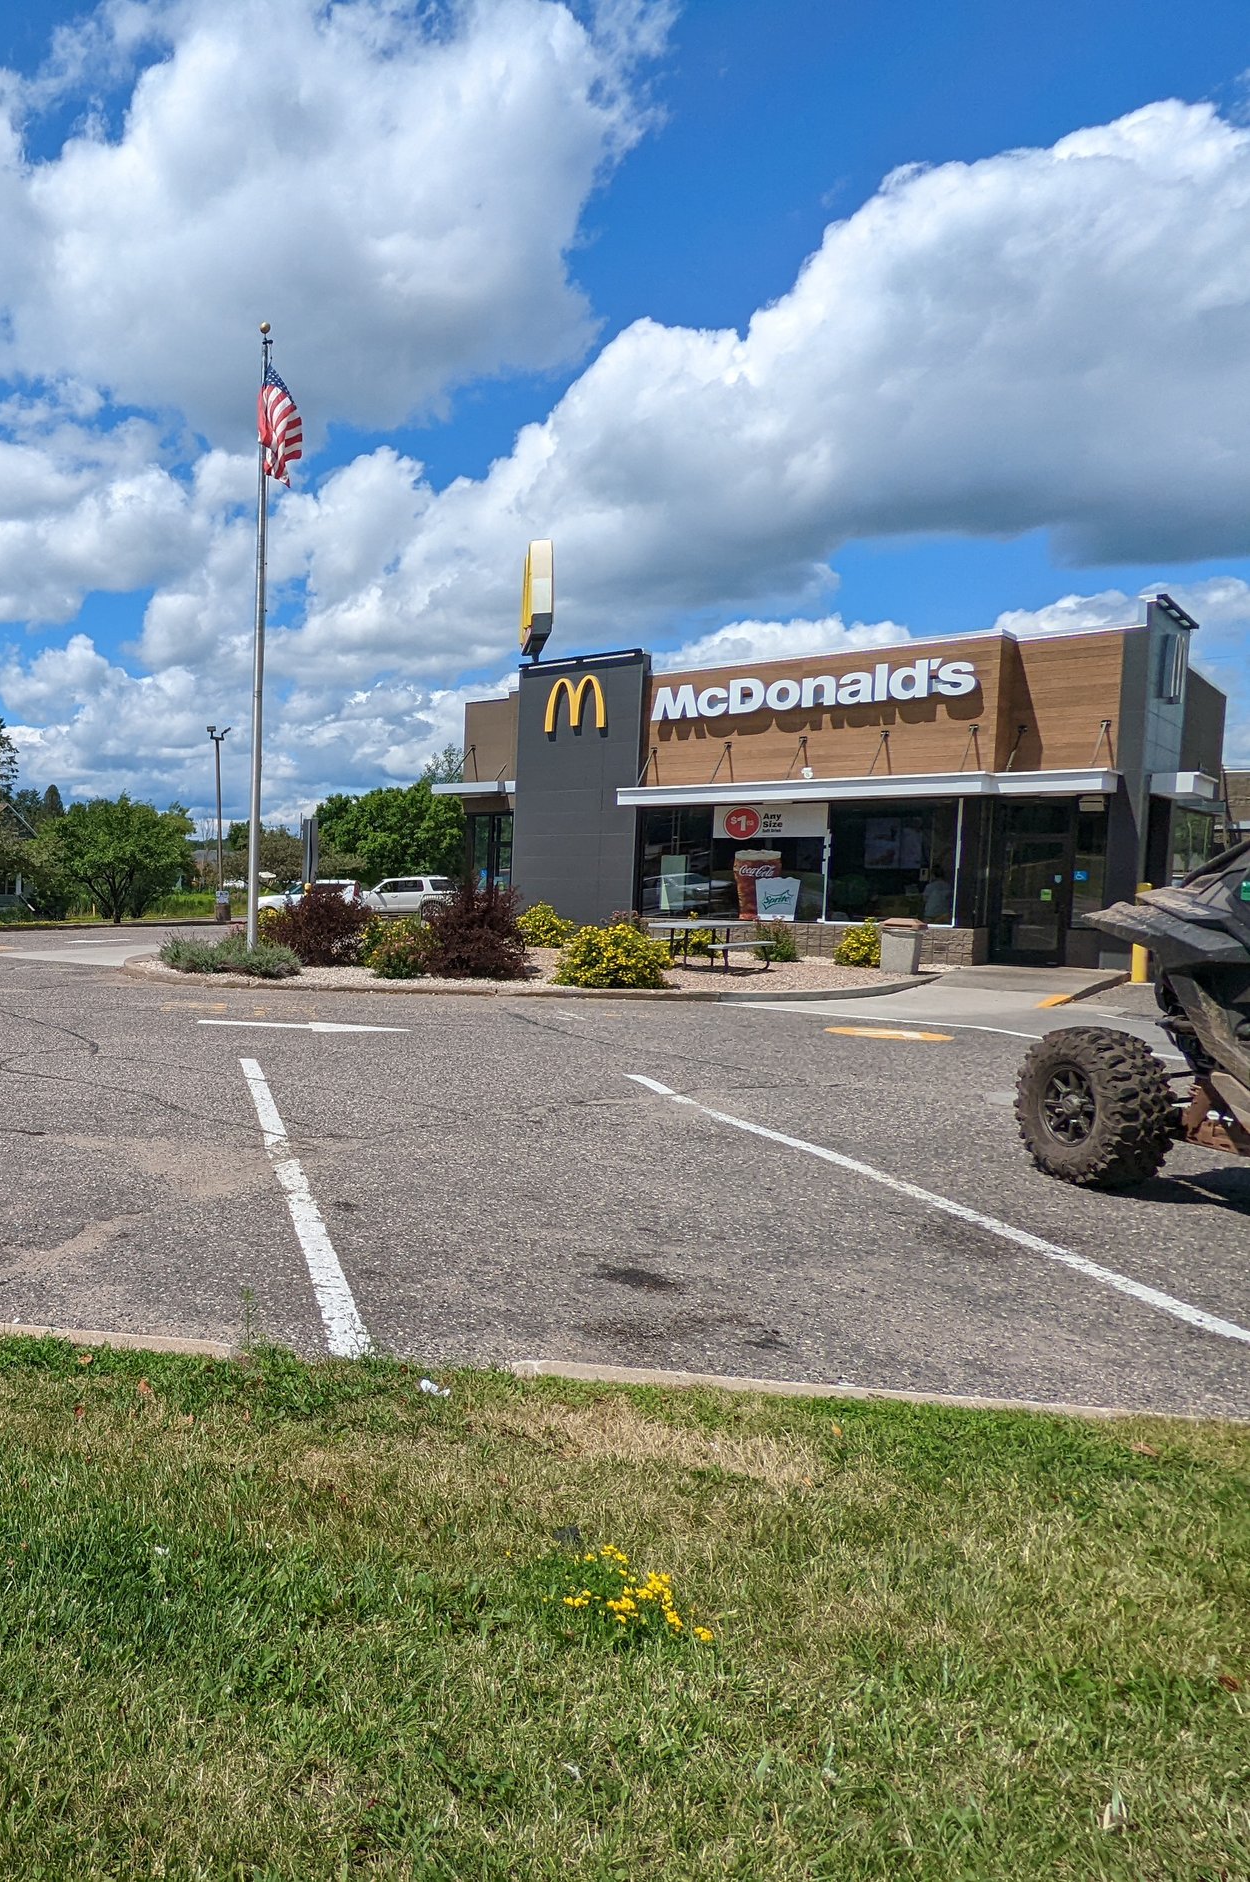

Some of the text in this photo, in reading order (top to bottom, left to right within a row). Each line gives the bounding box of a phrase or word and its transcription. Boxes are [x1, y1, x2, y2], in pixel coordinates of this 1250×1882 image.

[651, 657, 977, 721] McDonald's
[763, 813, 782, 821] Any
[762, 820, 783, 828] Size
[763, 895, 791, 904] Sprite
